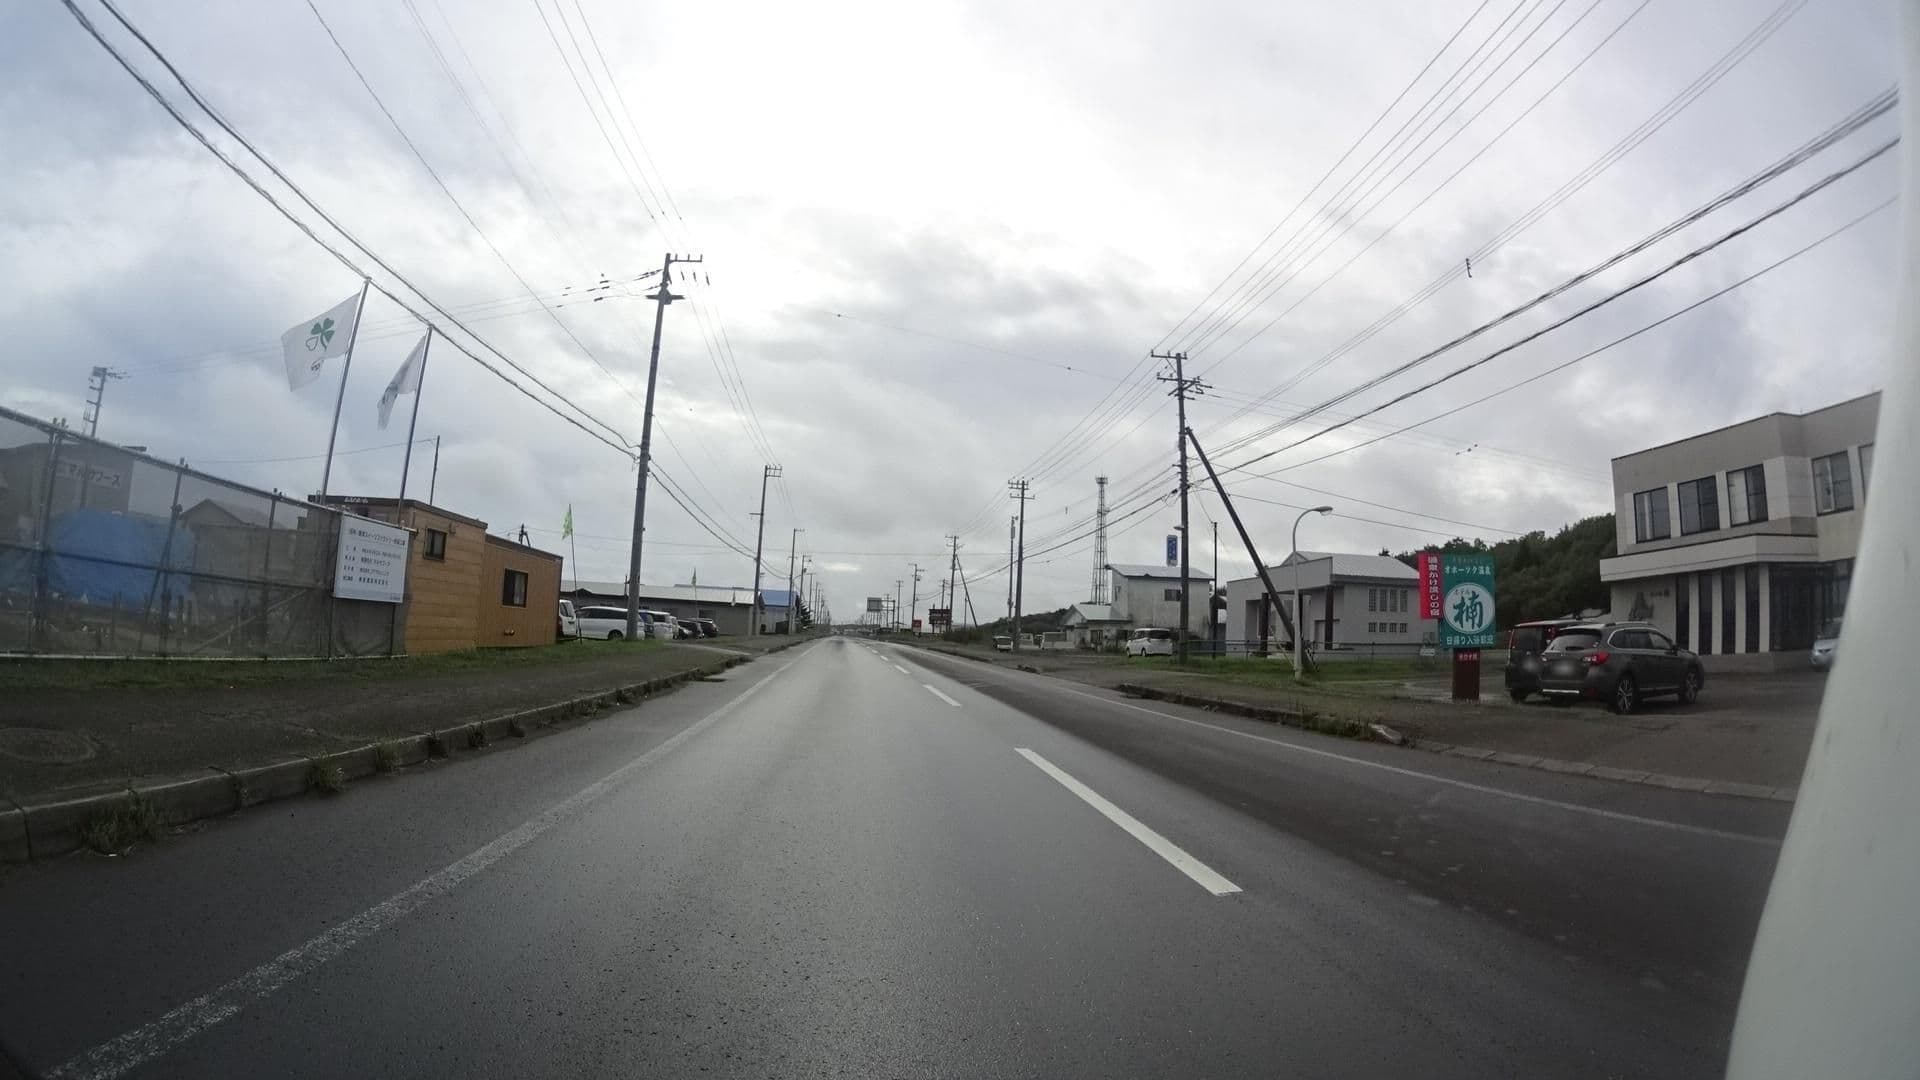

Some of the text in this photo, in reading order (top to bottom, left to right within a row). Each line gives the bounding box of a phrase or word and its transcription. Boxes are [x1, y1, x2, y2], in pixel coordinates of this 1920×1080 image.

[1444, 565, 1491, 575] オホーツク温泉
